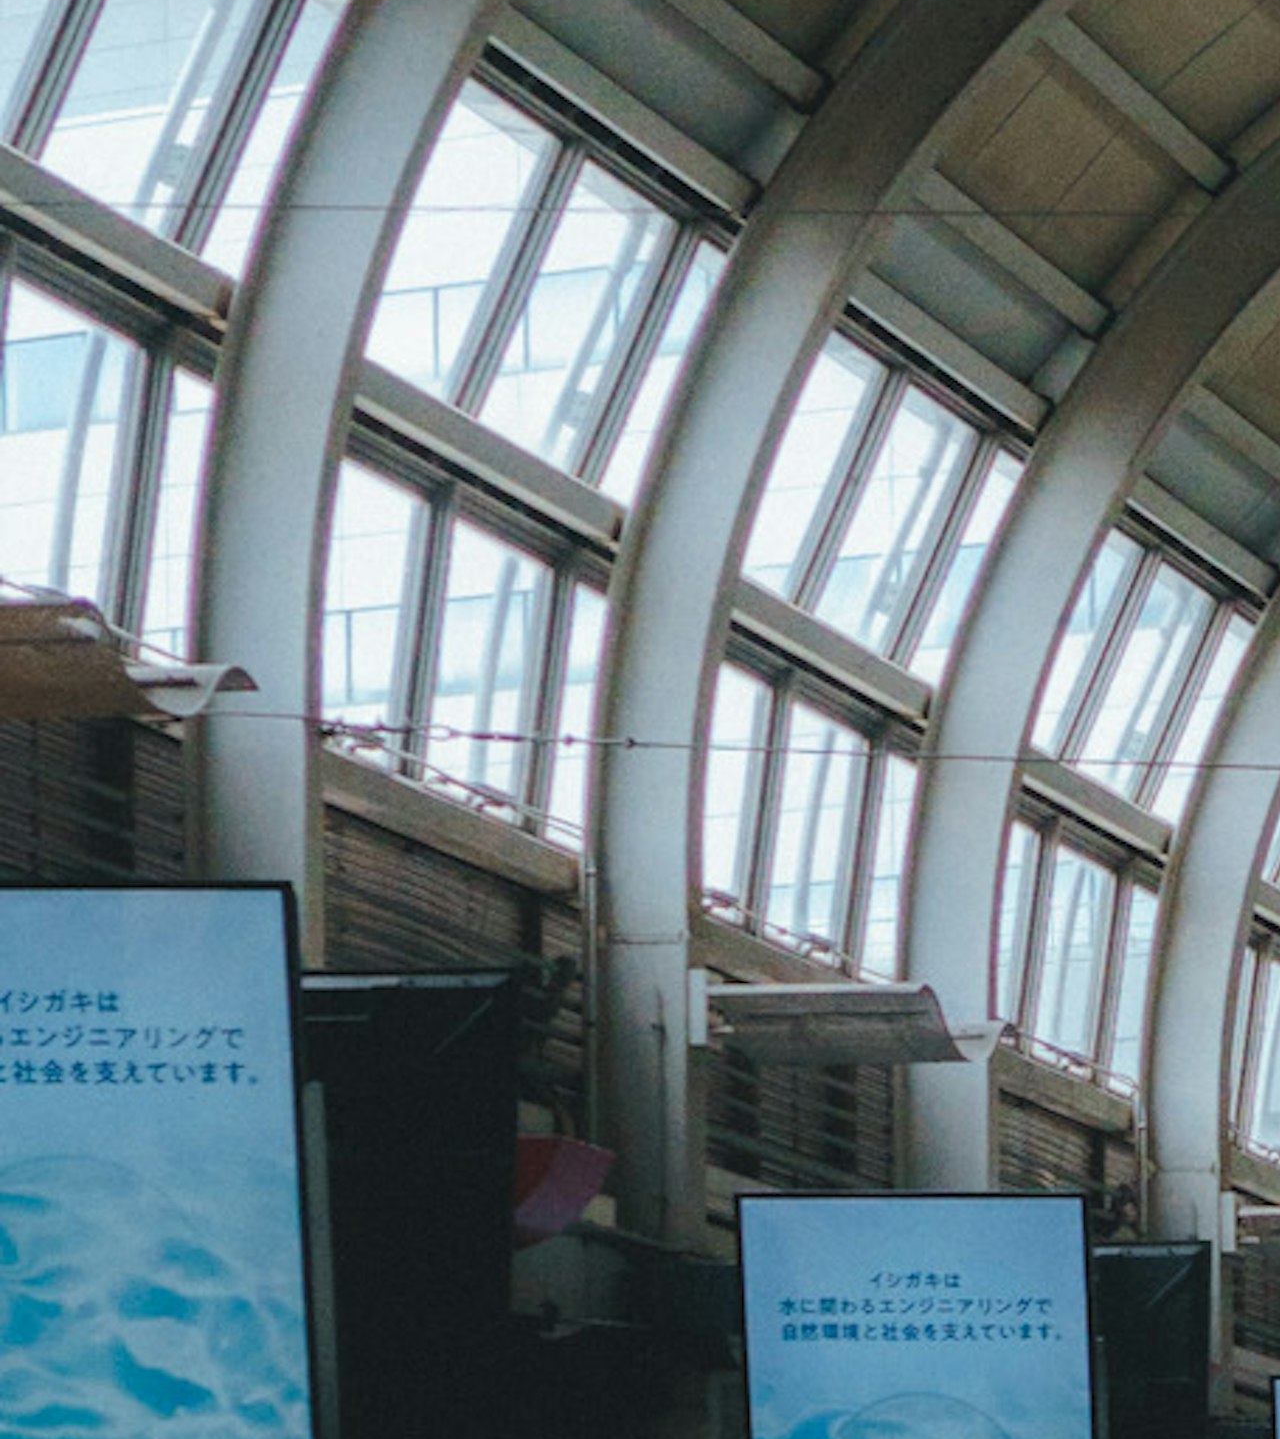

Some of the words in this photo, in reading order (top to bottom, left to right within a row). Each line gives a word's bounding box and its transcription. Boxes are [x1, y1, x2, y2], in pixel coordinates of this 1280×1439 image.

[0, 989, 119, 1012] イシガキは
[0, 1025, 245, 1049] エンジニアリングで
[869, 1271, 961, 1288] イシガキは
[779, 1296, 1052, 1315] 水に関わるエンジニアリングで
